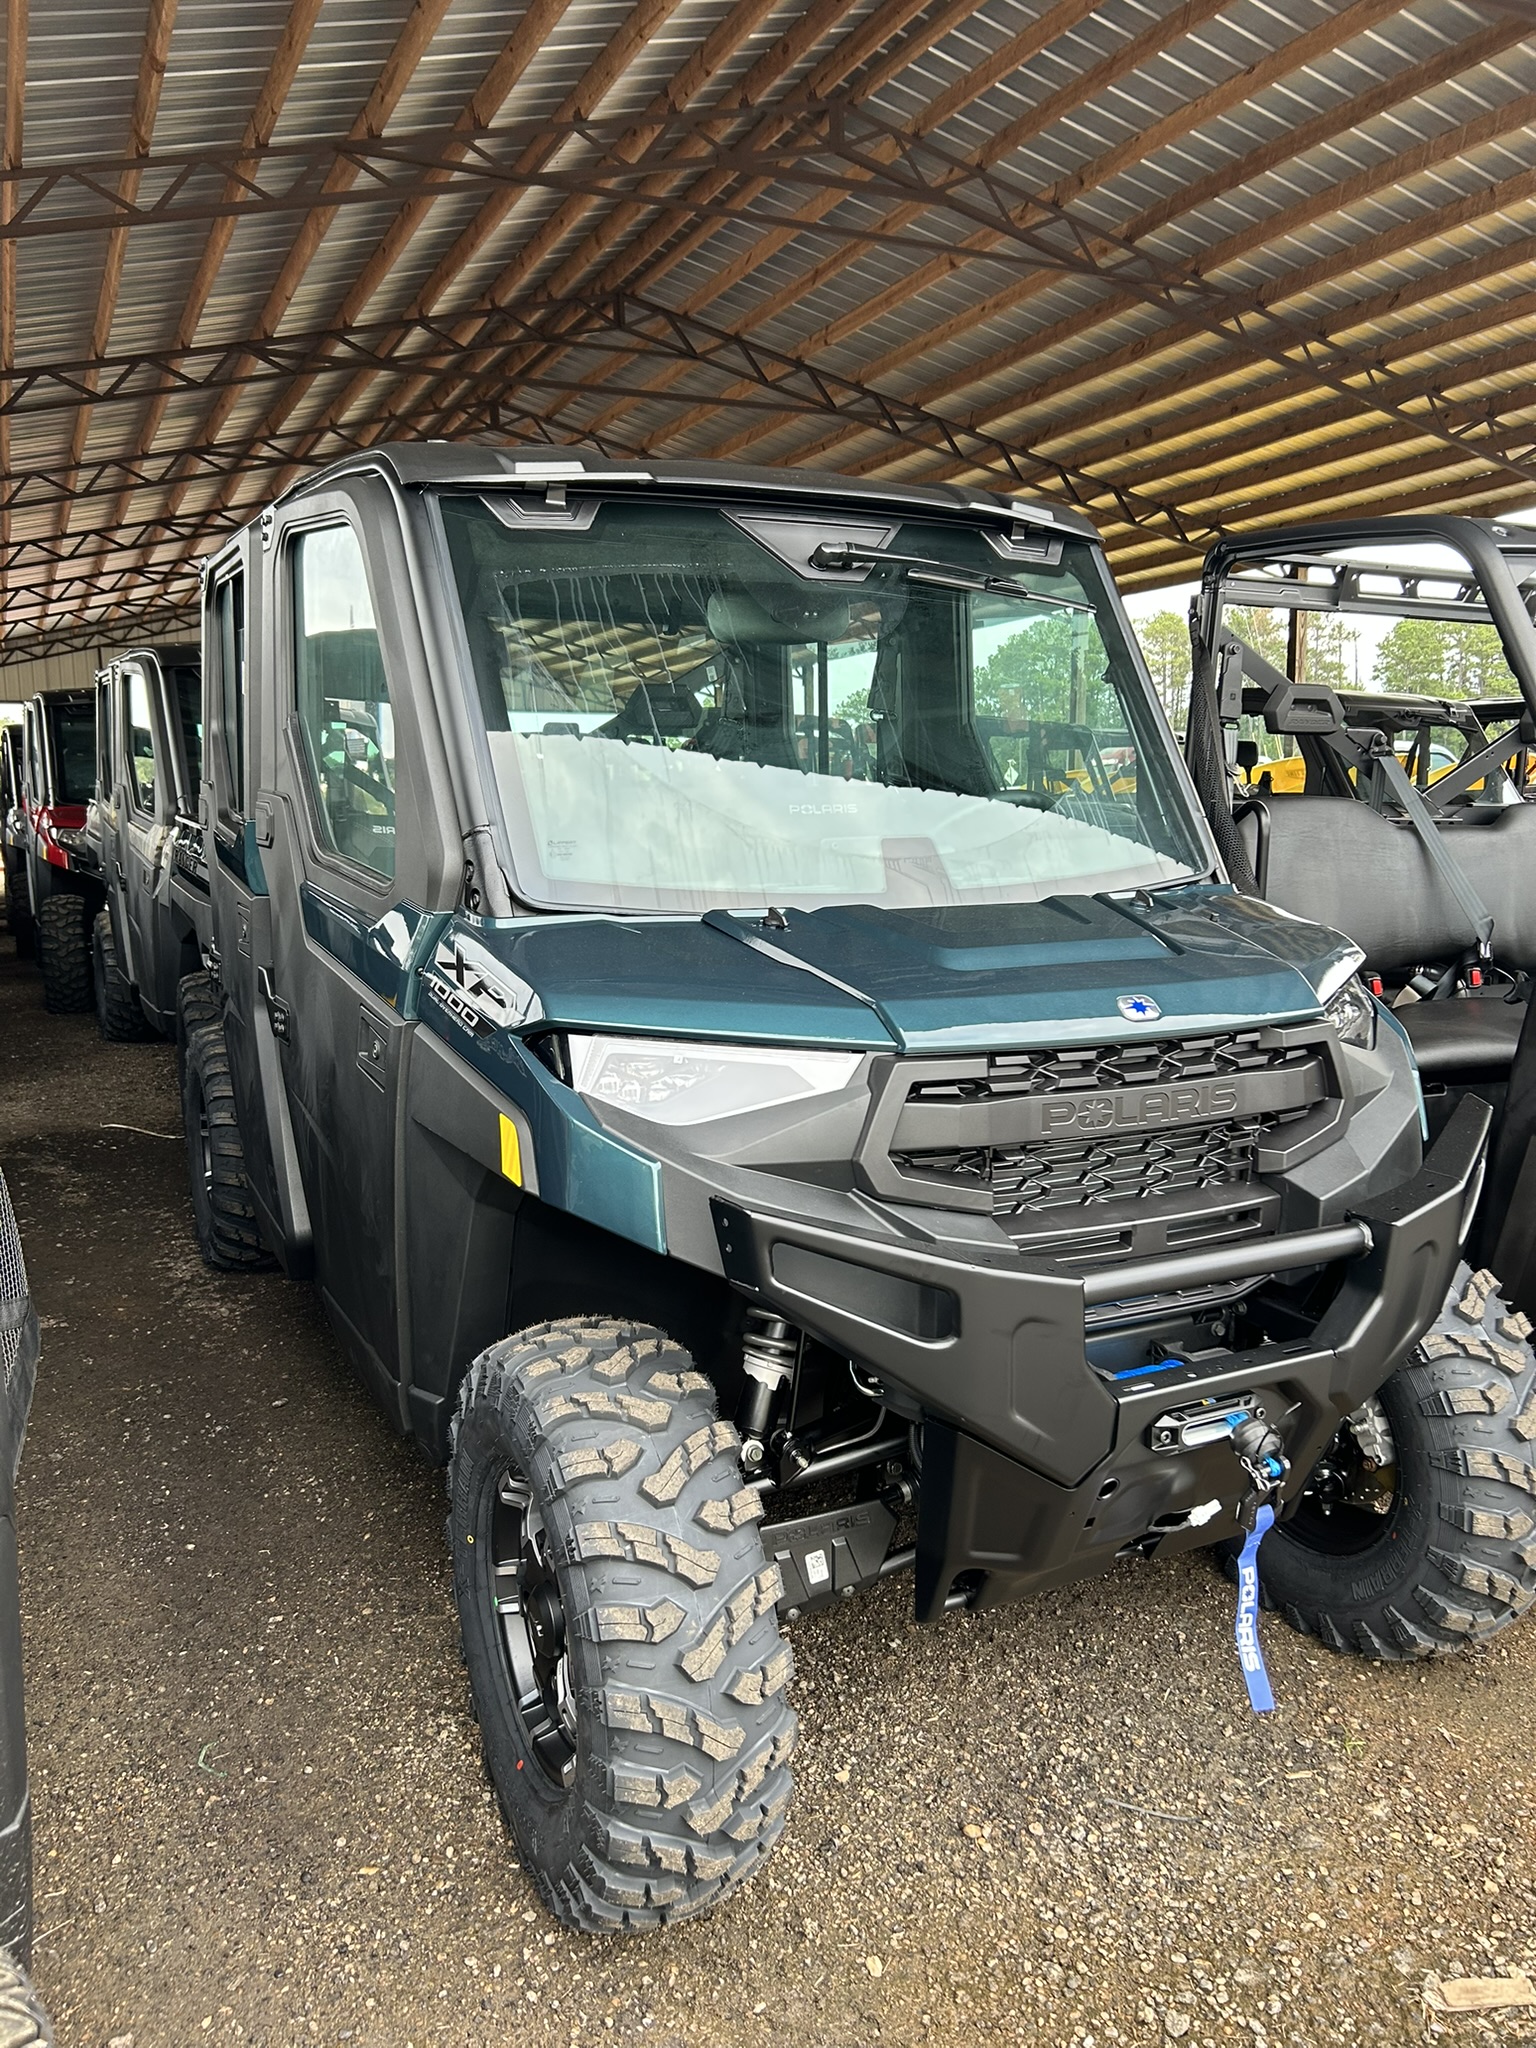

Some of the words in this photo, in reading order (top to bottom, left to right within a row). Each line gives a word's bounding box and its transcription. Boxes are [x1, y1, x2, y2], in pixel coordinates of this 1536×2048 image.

[788, 803, 859, 815] POLARIS
[425, 973, 480, 1027] 1000
[435, 941, 518, 1011] XP
[1041, 1081, 1238, 1135] POLARIS
[772, 1511, 872, 1547] POLARIS
[1239, 1565, 1262, 1672] POLARIS
